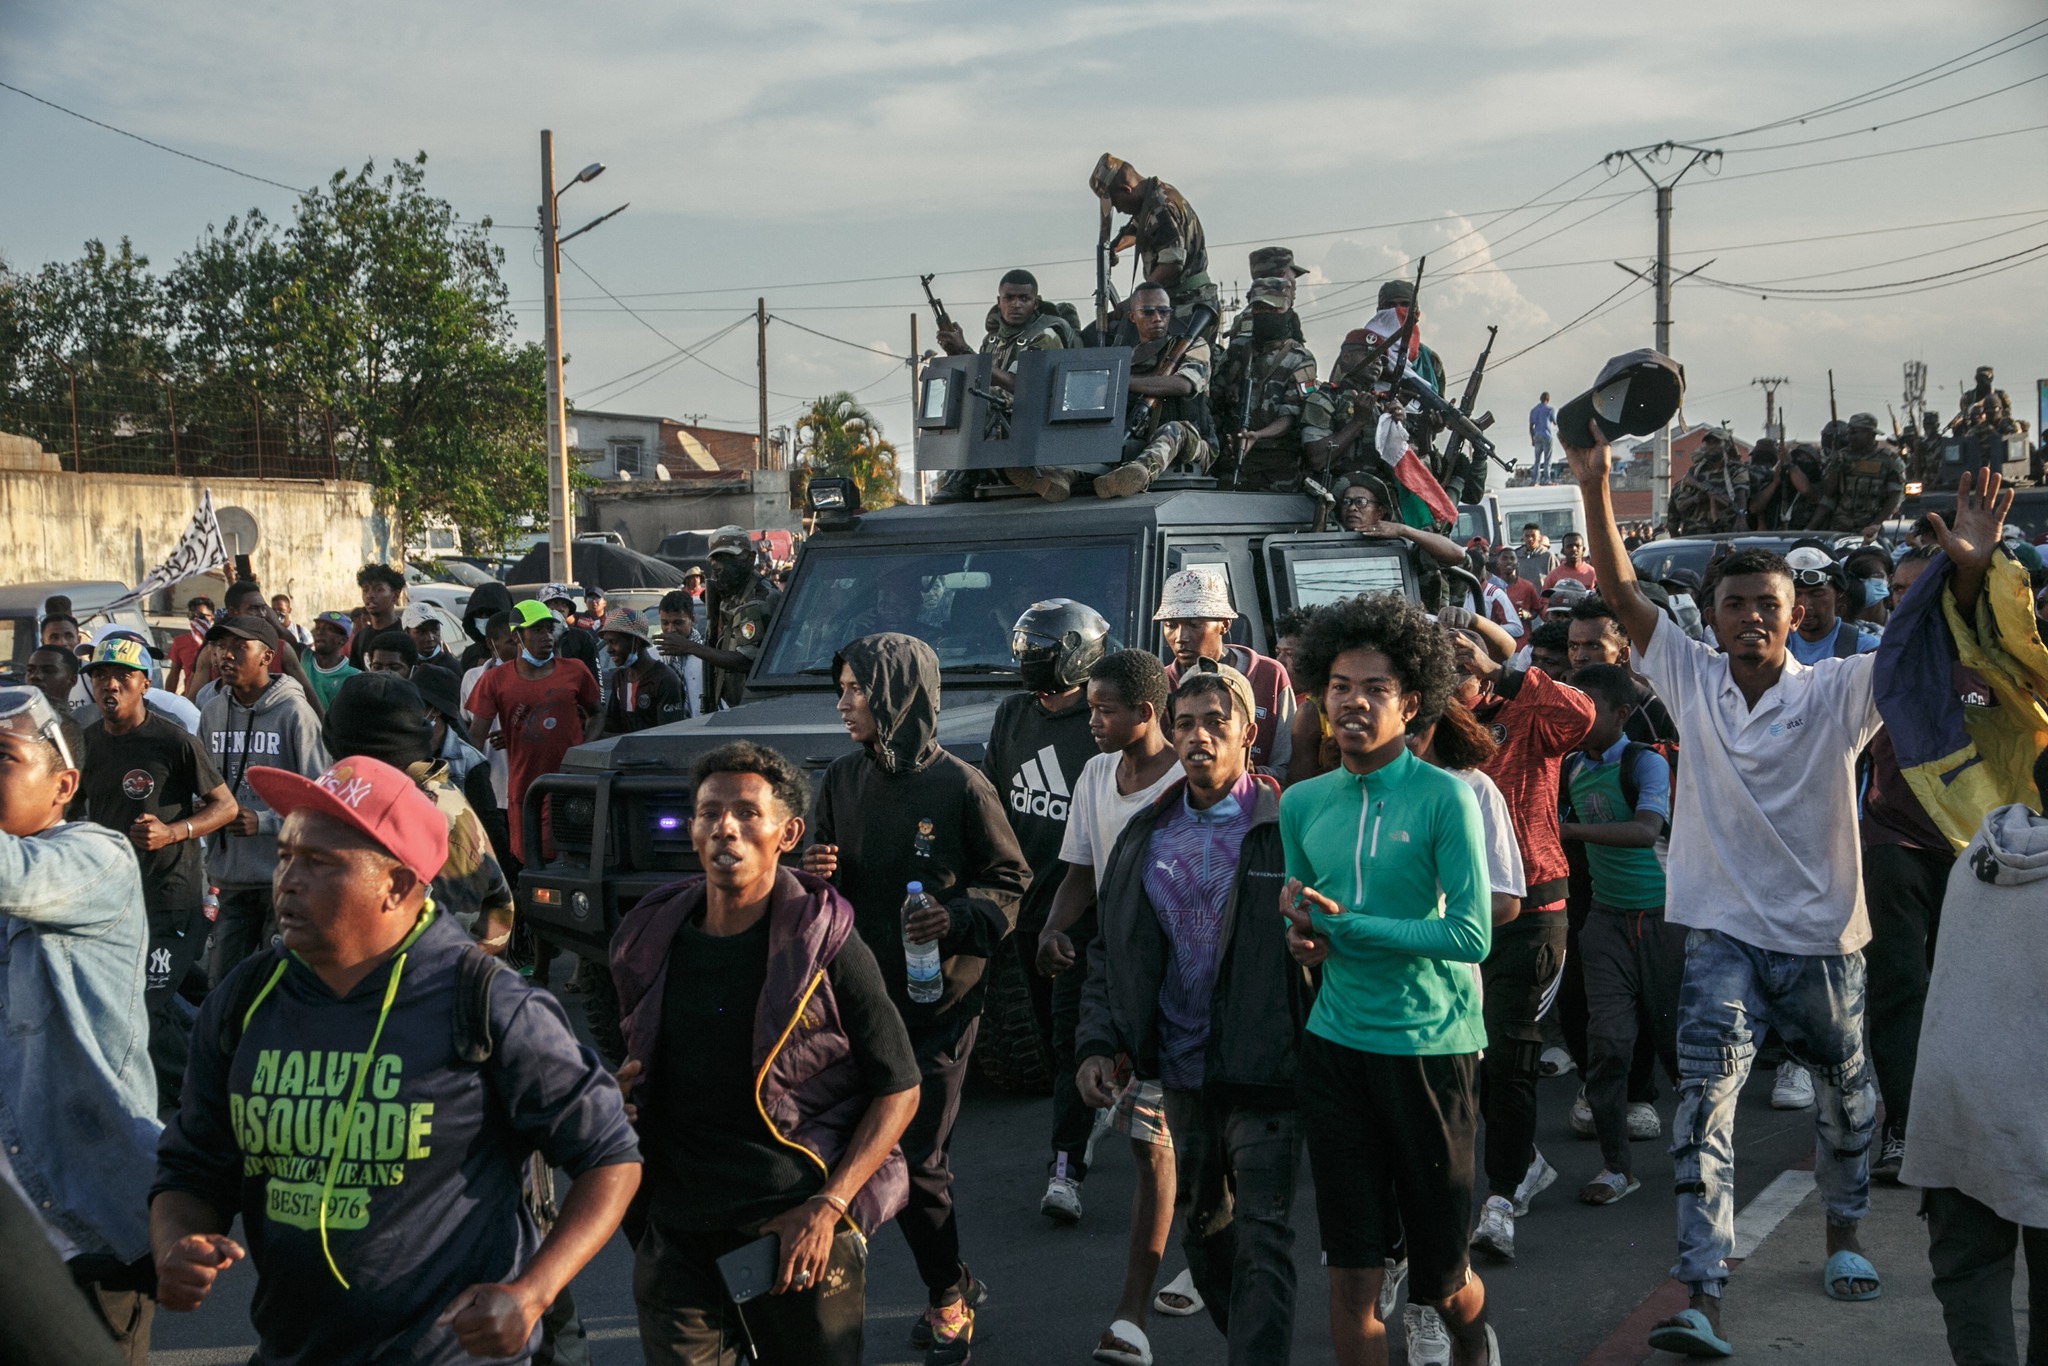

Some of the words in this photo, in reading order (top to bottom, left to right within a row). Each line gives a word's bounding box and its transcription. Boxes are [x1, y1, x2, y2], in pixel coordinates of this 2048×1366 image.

[211, 730, 281, 755] SENIOR
[1010, 786, 1072, 821] adida
[149, 947, 172, 973] NY
[229, 1092, 435, 1161] DSQUARDE
[270, 1187, 361, 1220] BEST-976
